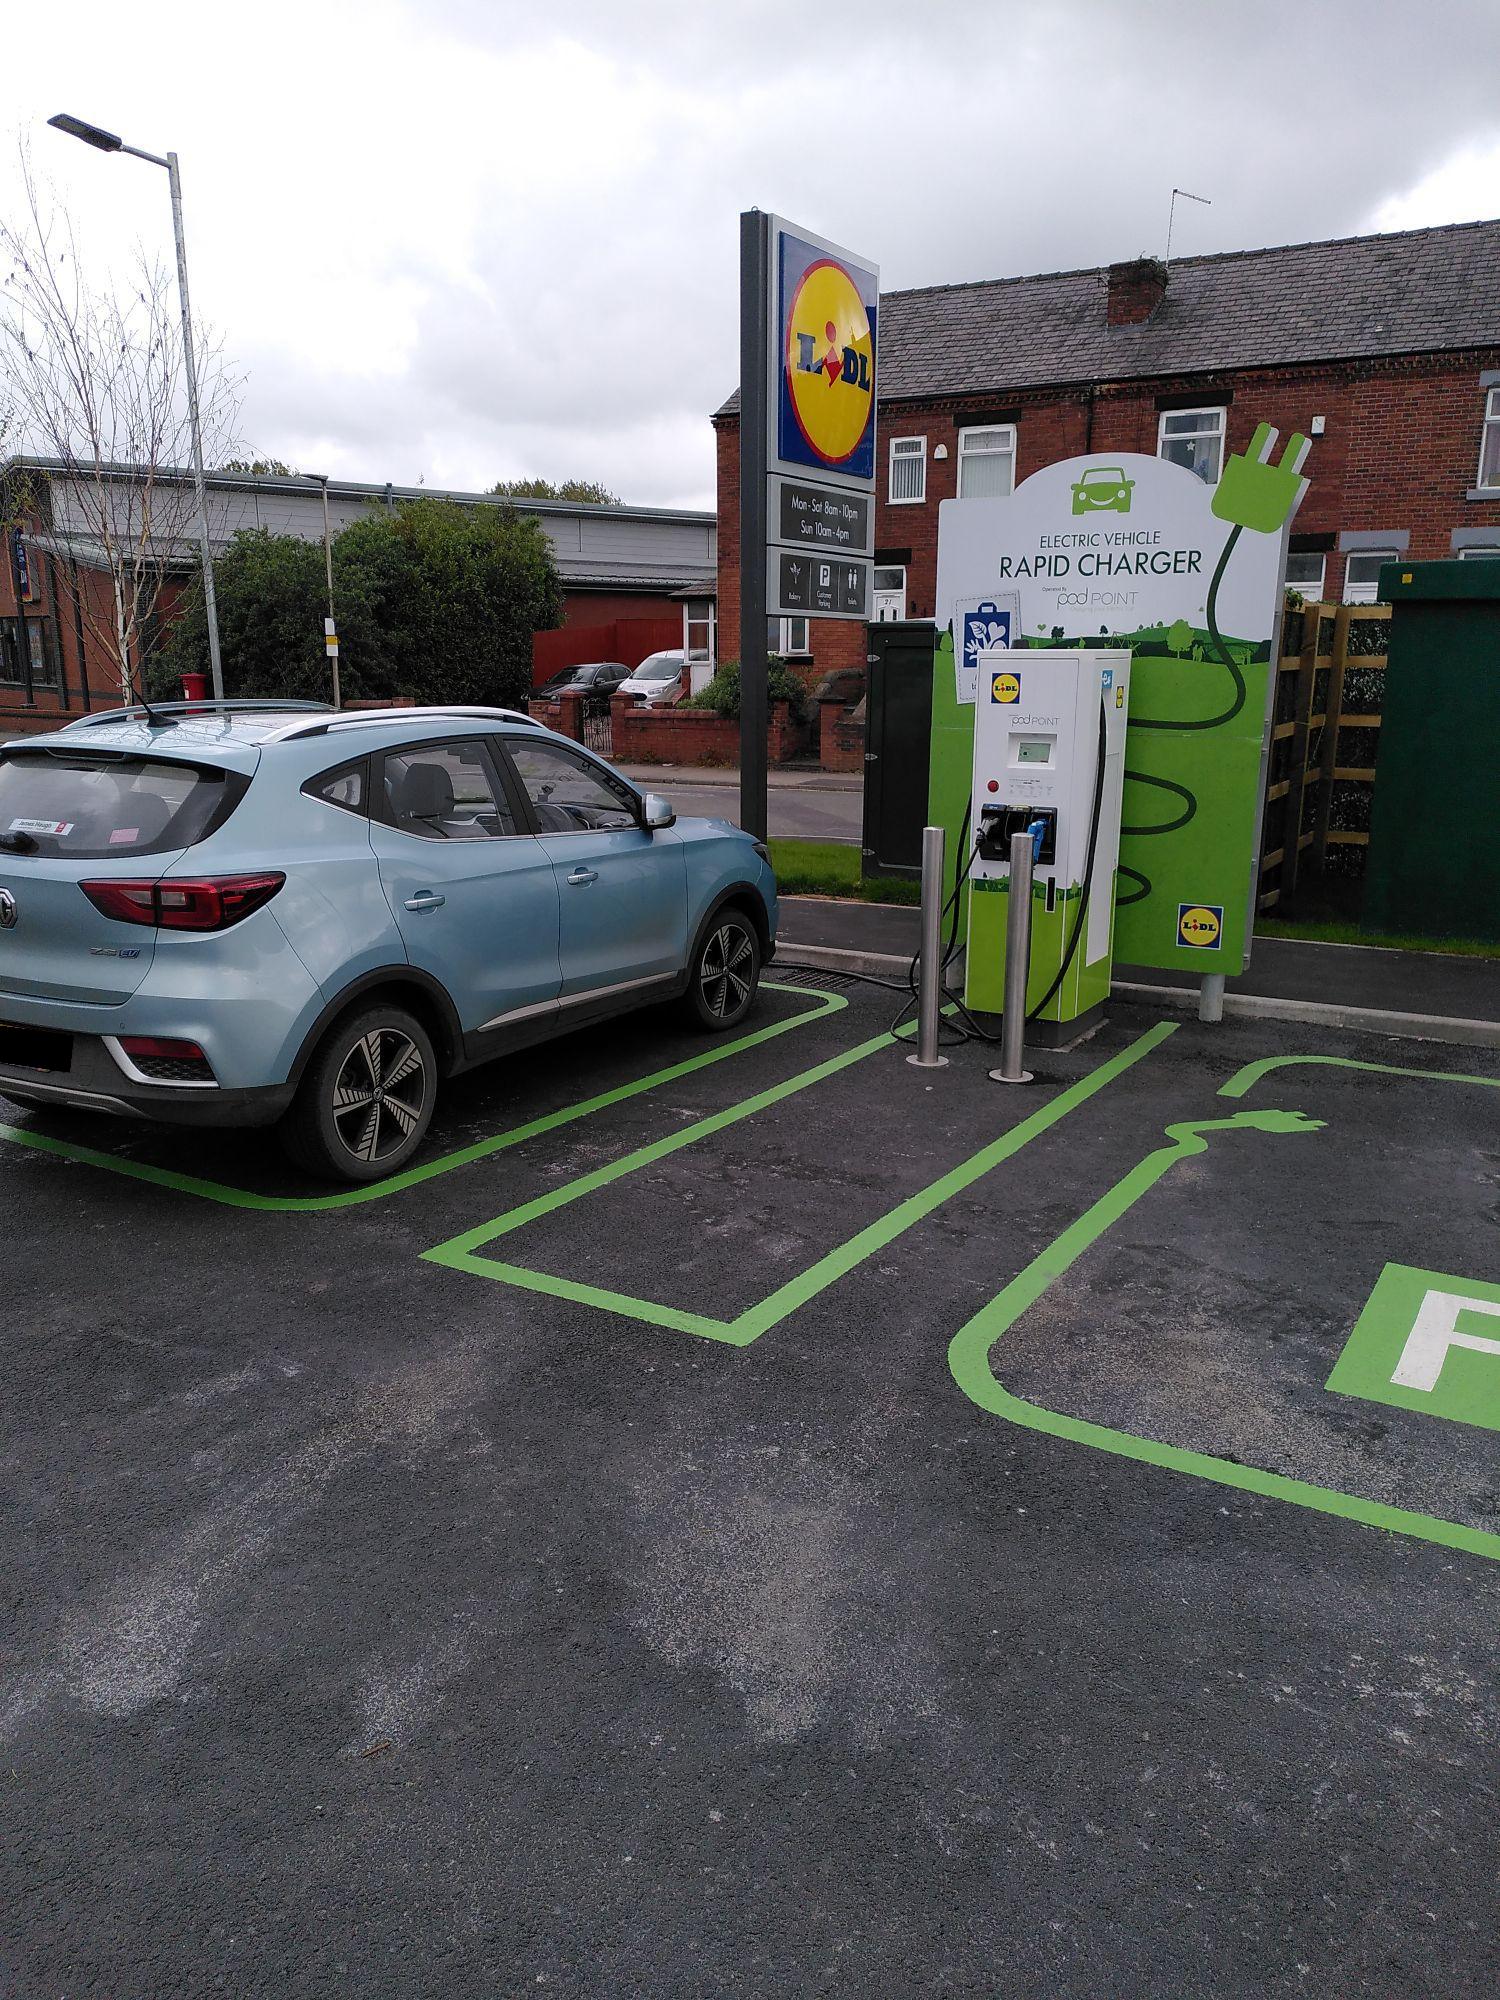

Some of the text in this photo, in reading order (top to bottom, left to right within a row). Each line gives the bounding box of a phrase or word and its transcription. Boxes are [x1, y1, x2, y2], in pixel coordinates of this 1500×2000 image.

[800, 519, 813, 535] Sun
[1040, 531, 1161, 548] ELECTRIC VEHICLE
[1000, 550, 1202, 578] RAPID CHARGER
[1057, 587, 1089, 610] pod
[1091, 591, 1139, 605] POINT
[1031, 716, 1061, 726] POINT
